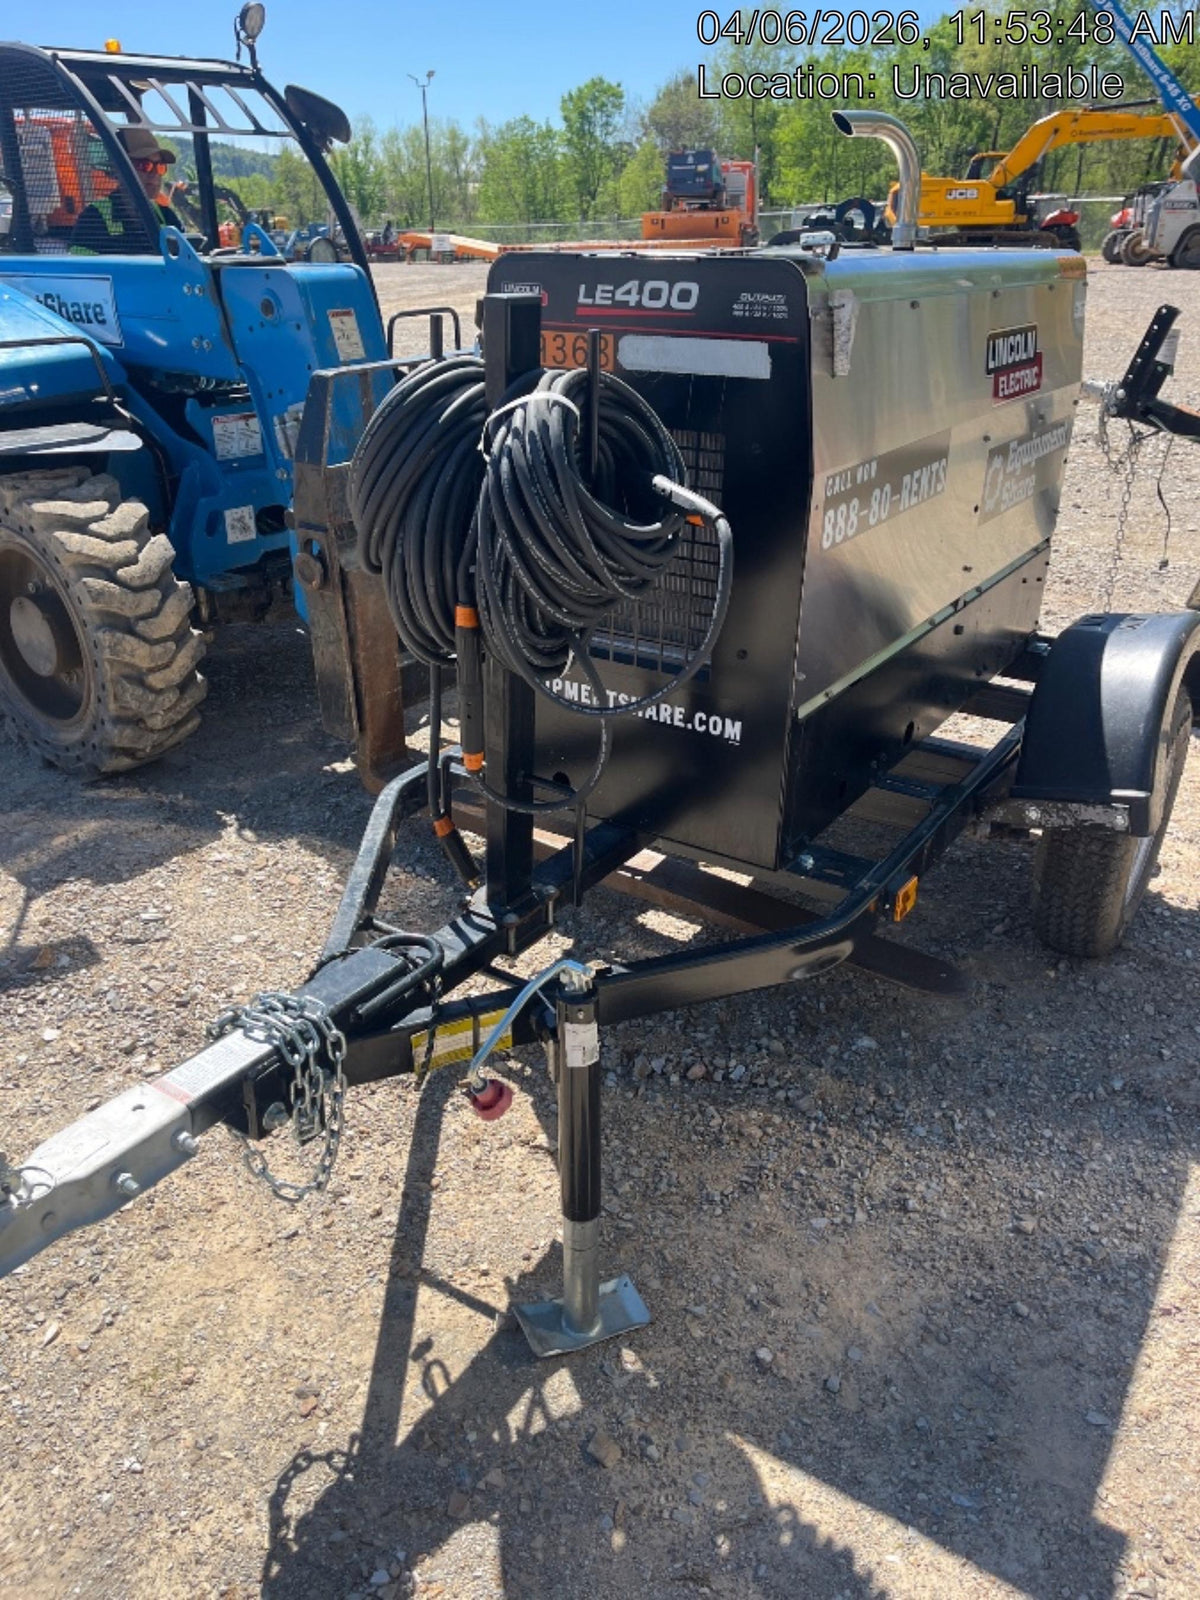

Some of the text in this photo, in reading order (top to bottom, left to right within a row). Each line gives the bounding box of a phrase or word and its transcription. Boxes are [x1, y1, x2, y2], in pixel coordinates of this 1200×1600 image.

[945, 188, 979, 200] JCB
[577, 279, 700, 310] LE400
[988, 329, 1036, 369] LINCOLN
[998, 365, 1040, 397] ELECTRIC
[822, 458, 948, 550] 888-80-RENTS
[545, 677, 743, 742] PMETSARE.COM
